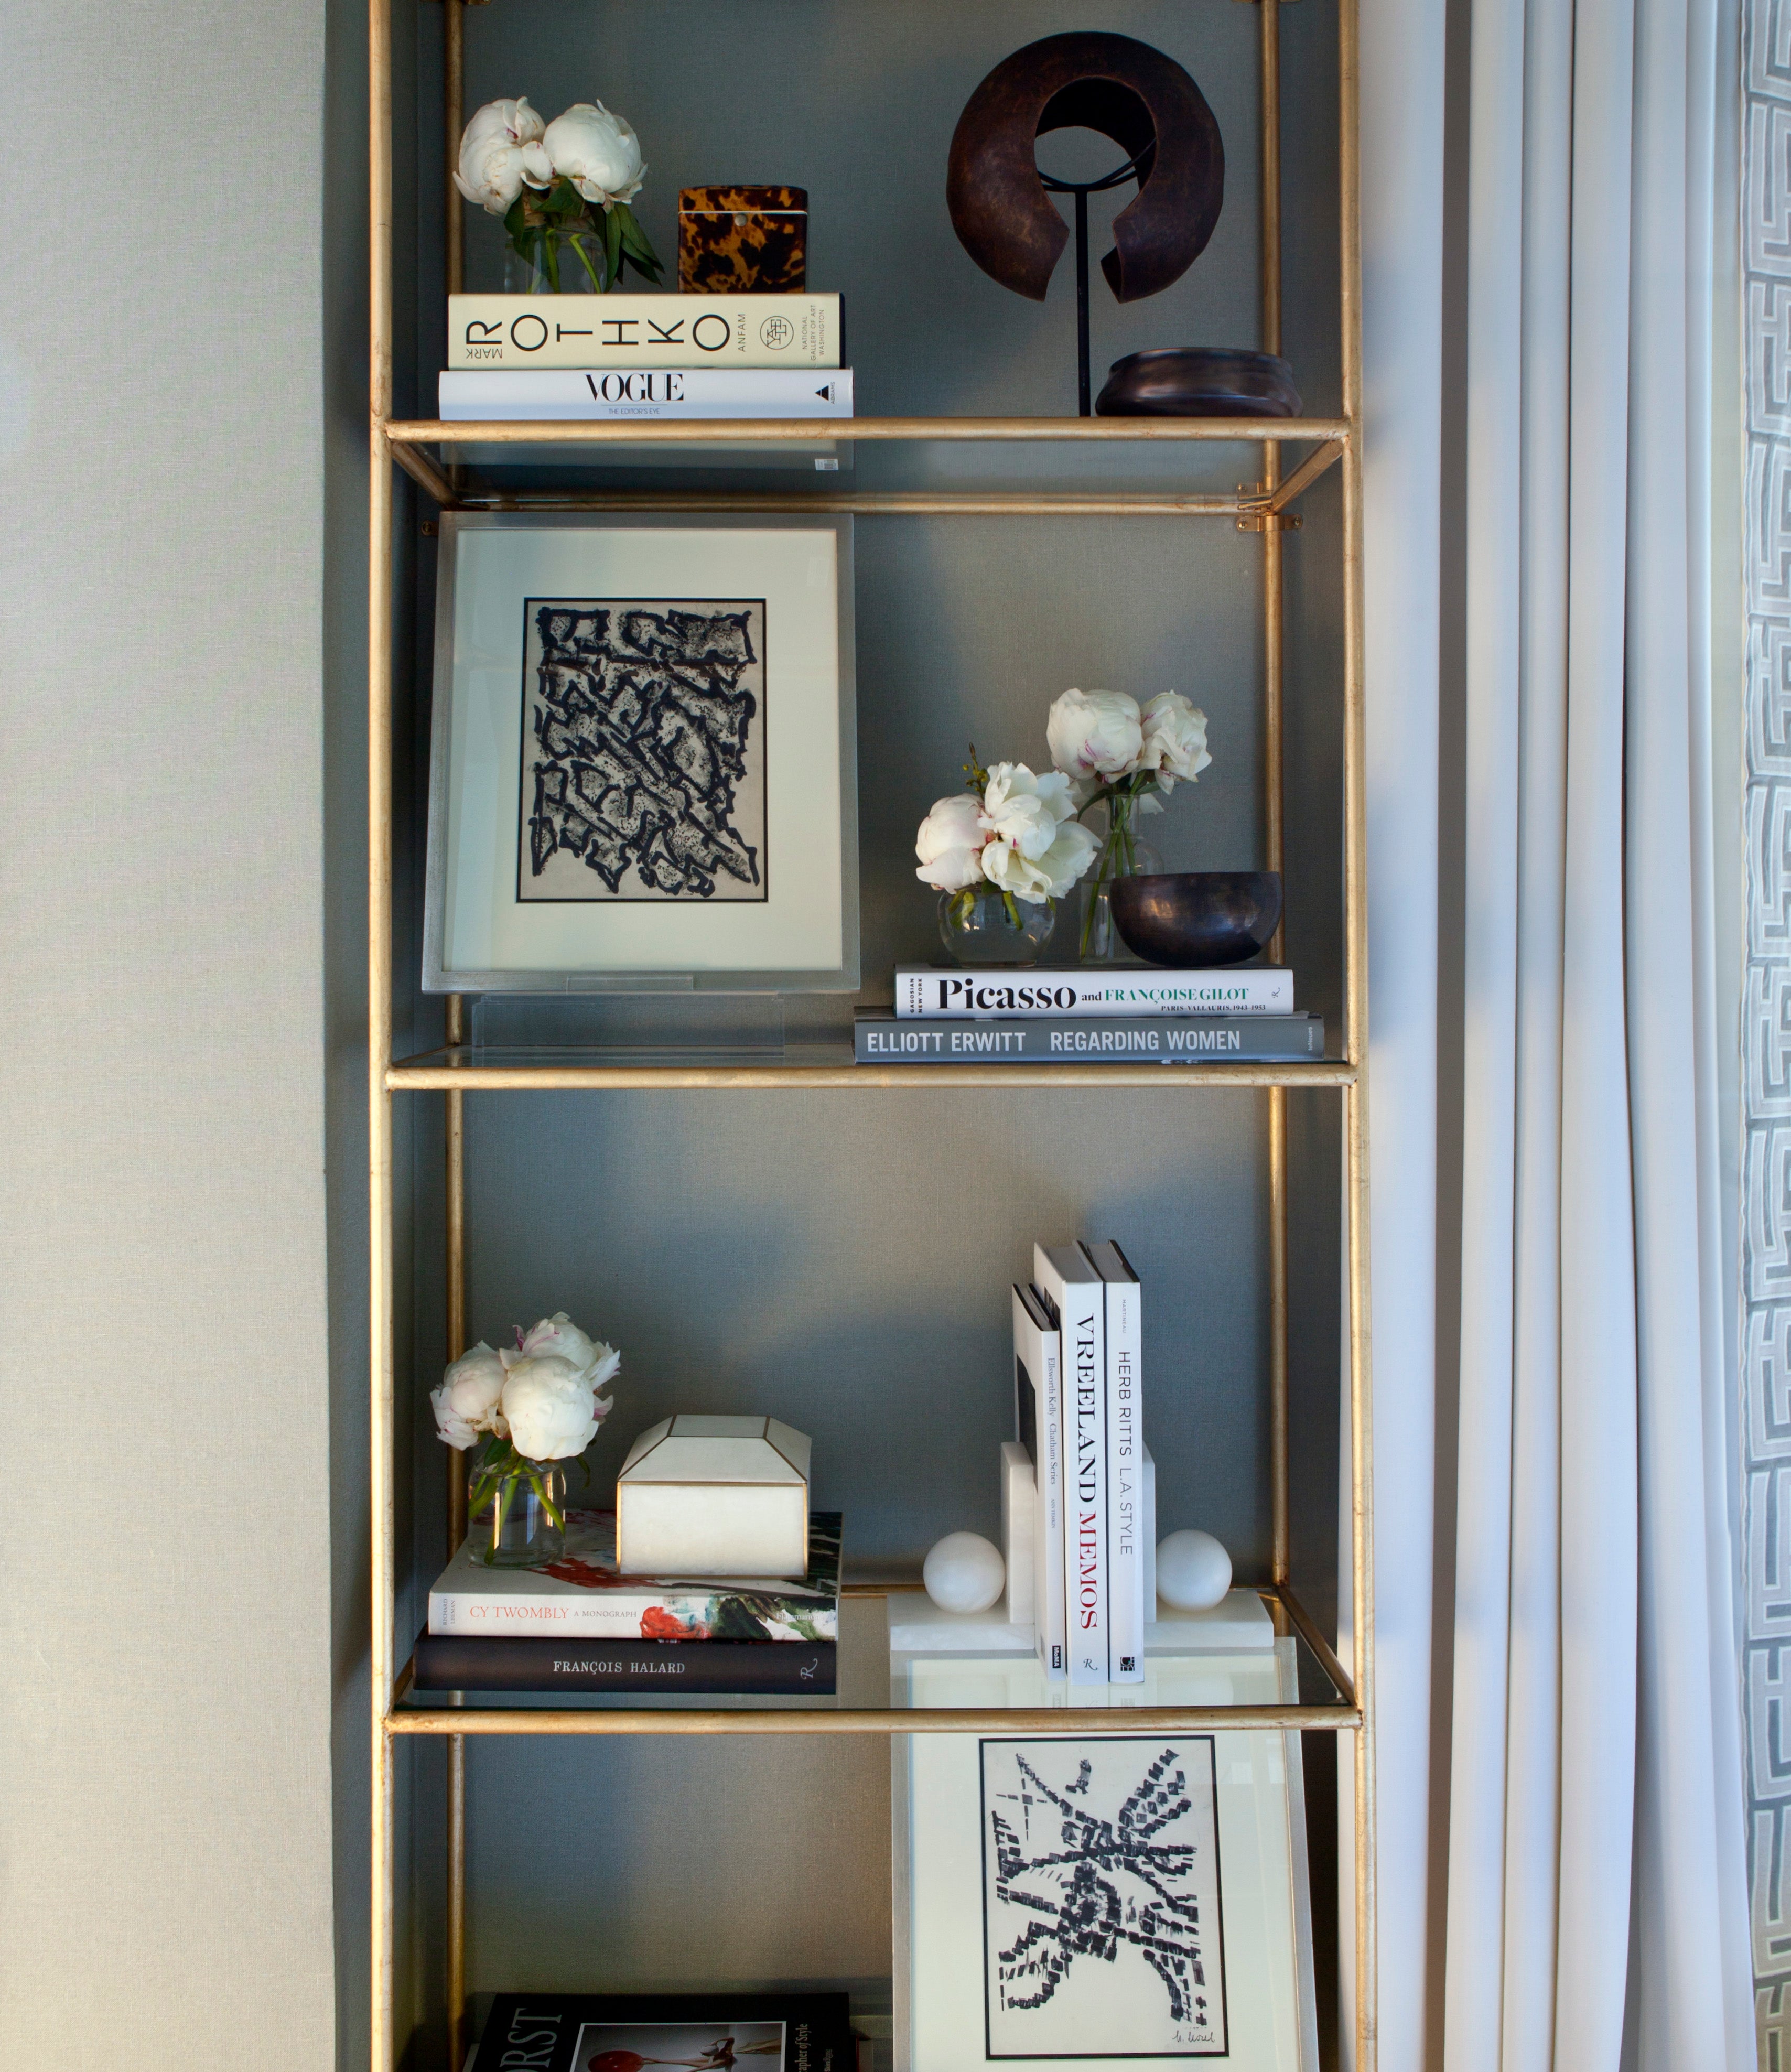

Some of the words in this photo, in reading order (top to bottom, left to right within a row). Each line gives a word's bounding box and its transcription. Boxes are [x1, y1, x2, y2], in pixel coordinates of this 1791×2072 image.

[466, 314, 730, 351] ROTHKO
[737, 313, 746, 352] ANFAM
[466, 348, 502, 359] MARK
[584, 373, 684, 402] VOGUE
[936, 978, 1076, 1009] Picasso
[1082, 991, 1102, 1001] and
[1105, 989, 1197, 1004] FRANÇOISE
[1200, 988, 1249, 1000] GILOT
[867, 1032, 943, 1052] ELLIOTT
[951, 1032, 1026, 1051] ERWITT
[1051, 1031, 1159, 1051] REGARDING
[1166, 1030, 1240, 1050] WOMEN
[1118, 1352, 1131, 1400] HERB
[1048, 1396, 1056, 1417] Kelly
[1077, 1312, 1096, 1503] VREELAND
[1049, 1423, 1058, 1459] Chatham
[1119, 1408, 1131, 1456] RITTS
[1050, 1462, 1059, 1485] Series
[1119, 1467, 1132, 1497] L.A.
[1120, 1502, 1132, 1555] STYLE
[1080, 1510, 1098, 1629] MEMOS
[470, 1606, 490, 1618] CY
[493, 1606, 569, 1619] TWOMBLY
[776, 1612, 820, 1621] Flammarion
[553, 1660, 622, 1675] FRANÇOIS
[630, 1662, 685, 1673] HALARD
[499, 2008, 562, 2072] RST
[795, 2024, 812, 2041] Style
[795, 2041, 811, 2049] of
